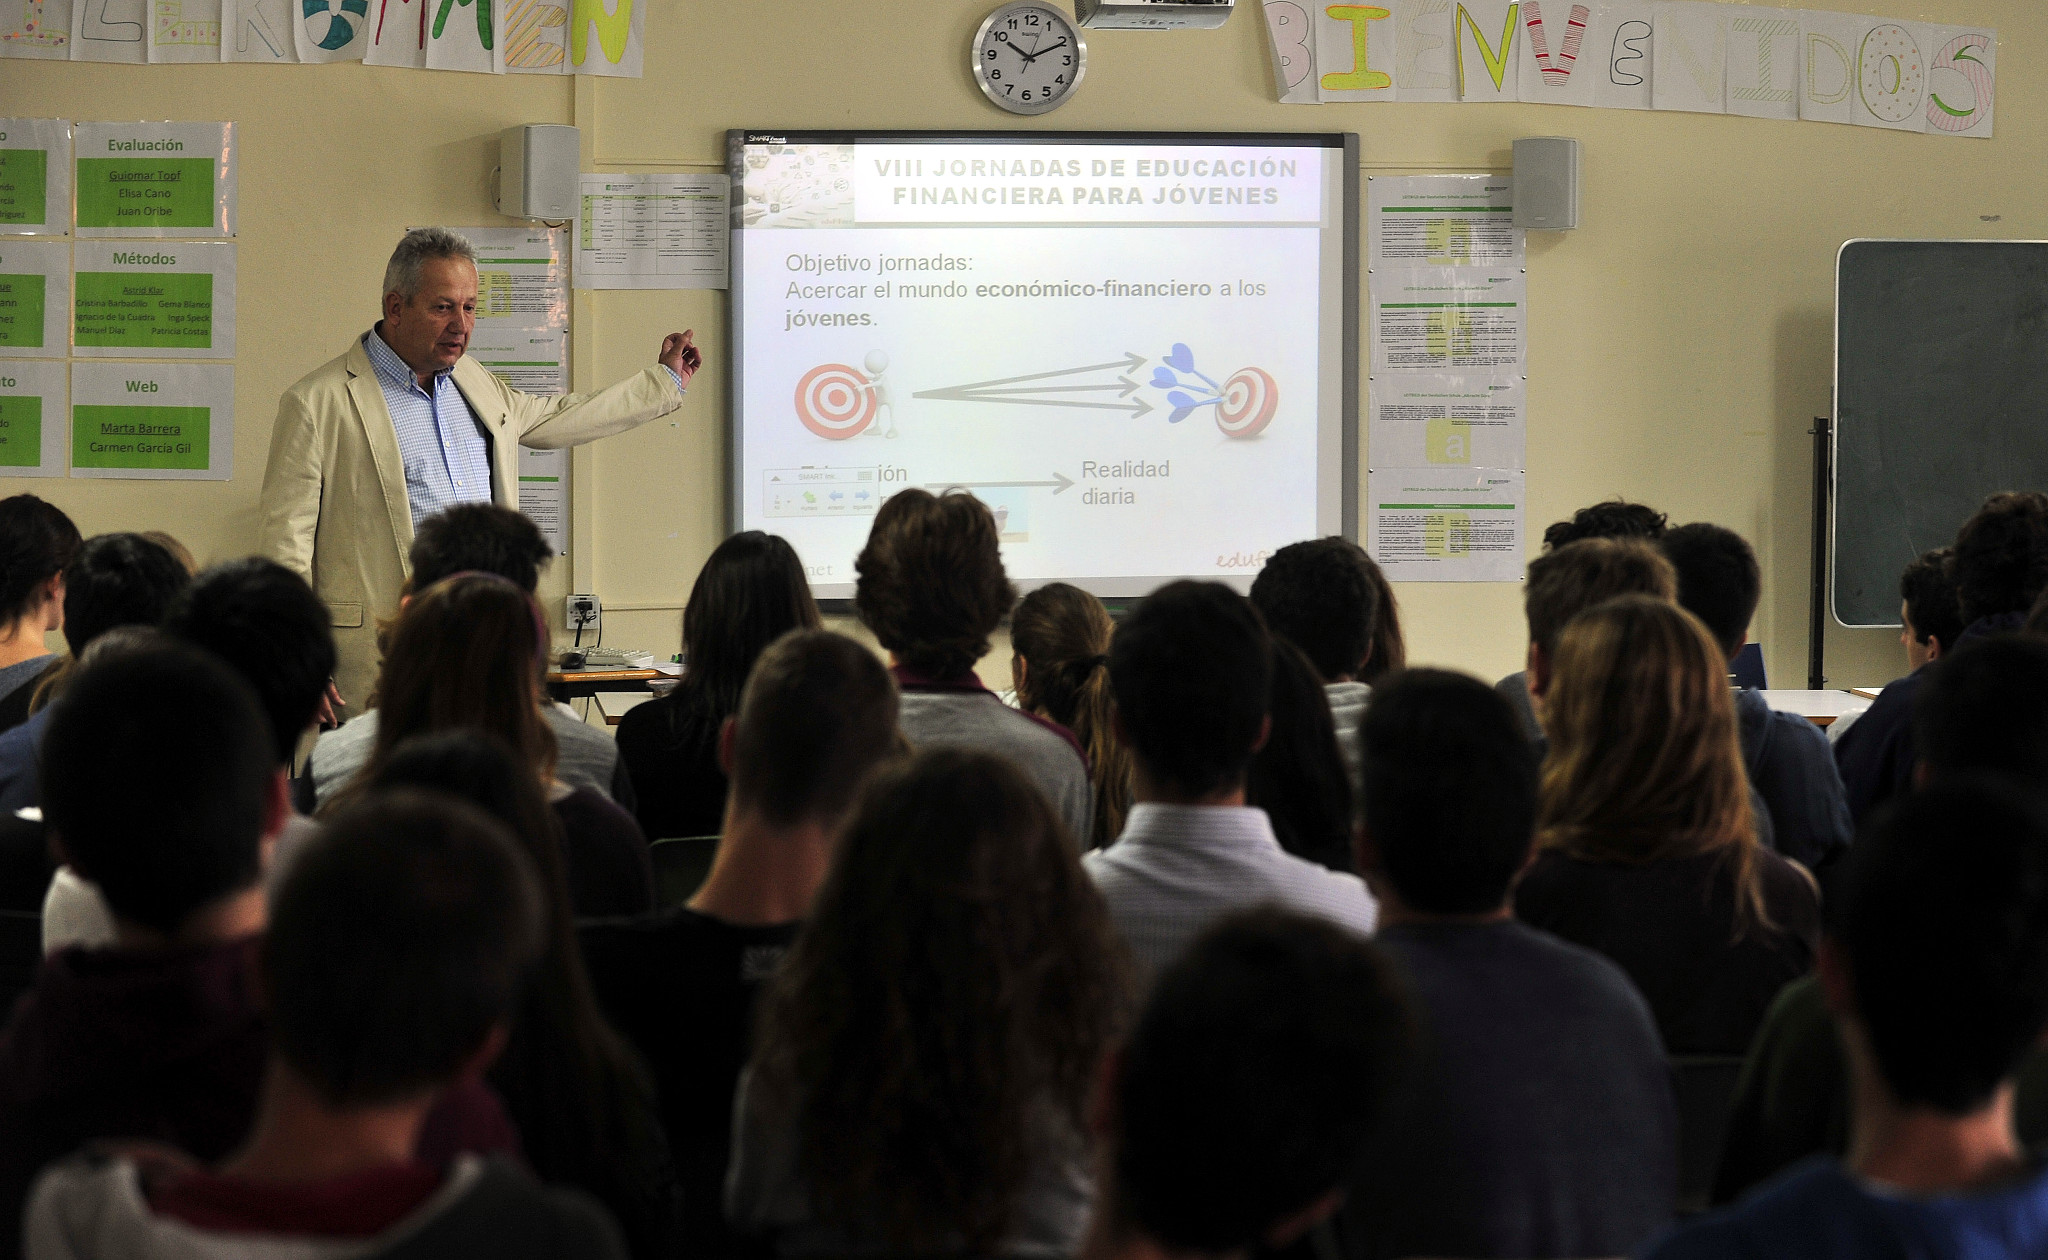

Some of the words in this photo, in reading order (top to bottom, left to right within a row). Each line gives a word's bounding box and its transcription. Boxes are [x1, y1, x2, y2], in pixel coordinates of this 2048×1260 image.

[1007, 19, 1018, 30] 11
[1024, 15, 1039, 26] 12
[1045, 20, 1052, 31] 1
[993, 31, 1008, 42] 10
[987, 49, 997, 60] 9
[1062, 55, 1071, 66] 3
[1262, 0, 1994, 133] BIENVENIDOS
[991, 69, 1001, 80] 8
[1055, 74, 1065, 85] 4
[1004, 84, 1014, 95] 7
[1042, 86, 1051, 97] 5
[1021, 90, 1031, 101] 6
[108, 139, 183, 151] Evaluación
[874, 159, 922, 176] VIII
[932, 159, 1081, 176] JORNADAS
[1091, 160, 1125, 177] DE
[1136, 156, 1296, 177] EDUCACIÓN
[109, 170, 153, 181] Guiomar
[158, 170, 181, 182] Topf
[119, 189, 142, 198] Elisa
[145, 189, 171, 198] Cano
[894, 187, 1064, 205] FINANCIERA
[1072, 187, 1144, 205] PARA
[1152, 183, 1279, 205] JÓVENES
[116, 207, 141, 216] Juan
[144, 207, 173, 216] Oribe
[113, 252, 176, 265] Métodos
[786, 253, 872, 276] Objetivo
[877, 253, 973, 276] jornadas:
[122, 286, 147, 295] Astrid
[149, 286, 164, 295] Klar
[785, 281, 867, 299] Acercar
[873, 280, 891, 298] el
[899, 280, 968, 298] mundo
[975, 279, 1212, 298] económico-financiero
[1219, 283, 1231, 297] a
[1238, 279, 1267, 297] los
[76, 299, 107, 308] Cristina
[158, 300, 182, 309] Gema
[184, 300, 210, 309] Blanco
[106, 313, 116, 321] de
[127, 313, 155, 321] Cuadra
[784, 309, 878, 331] jóvenes.
[77, 326, 107, 334] Manuel
[152, 327, 181, 336] Patricia
[183, 328, 208, 336] Costas
[126, 380, 158, 393] Web
[101, 423, 135, 435] Marta
[139, 423, 181, 435] Barrera
[90, 442, 134, 453] Carmen
[137, 442, 173, 454] García
[176, 443, 191, 454] Gil
[1082, 460, 1170, 478] Realidad
[1082, 487, 1135, 504] diaria
